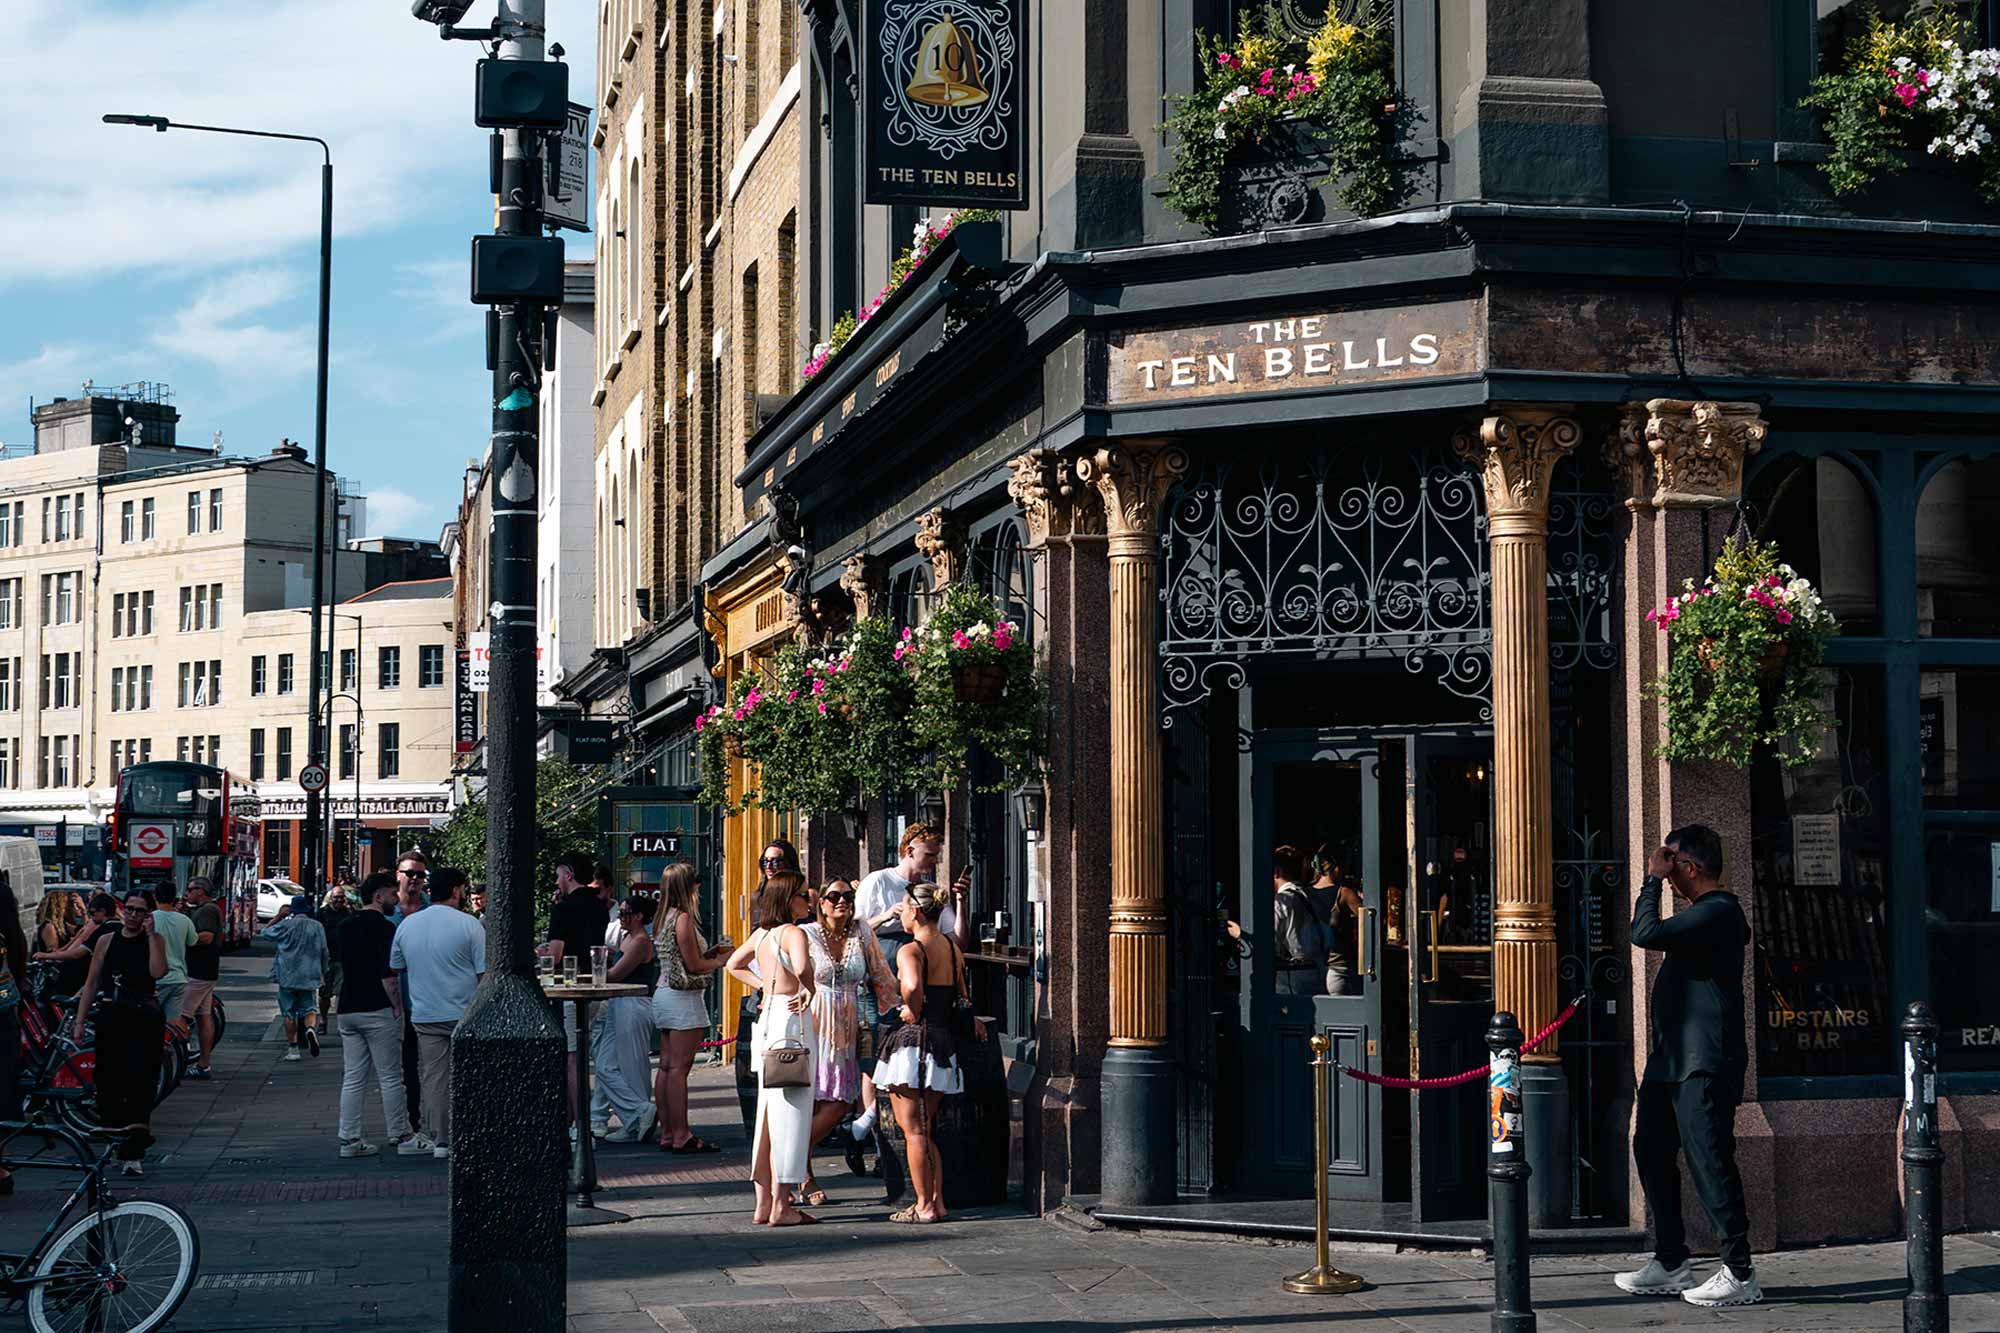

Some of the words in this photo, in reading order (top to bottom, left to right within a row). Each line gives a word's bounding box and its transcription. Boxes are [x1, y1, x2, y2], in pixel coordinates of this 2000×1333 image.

[932, 43, 965, 72] 10
[567, 117, 587, 138] TV
[879, 167, 915, 183] THE
[922, 169, 958, 185] TEN
[964, 171, 1016, 187] BELLS
[1249, 317, 1323, 344] THE
[1137, 352, 1236, 389] TEN
[1264, 333, 1440, 378] BELLS
[460, 693, 474, 712] MAN
[304, 772, 324, 783] 20
[186, 822, 206, 836] 242
[632, 838, 678, 852] FLAT
[1767, 1009, 1870, 1029] UPSTAIRS
[1797, 1032, 1841, 1049] BAR
